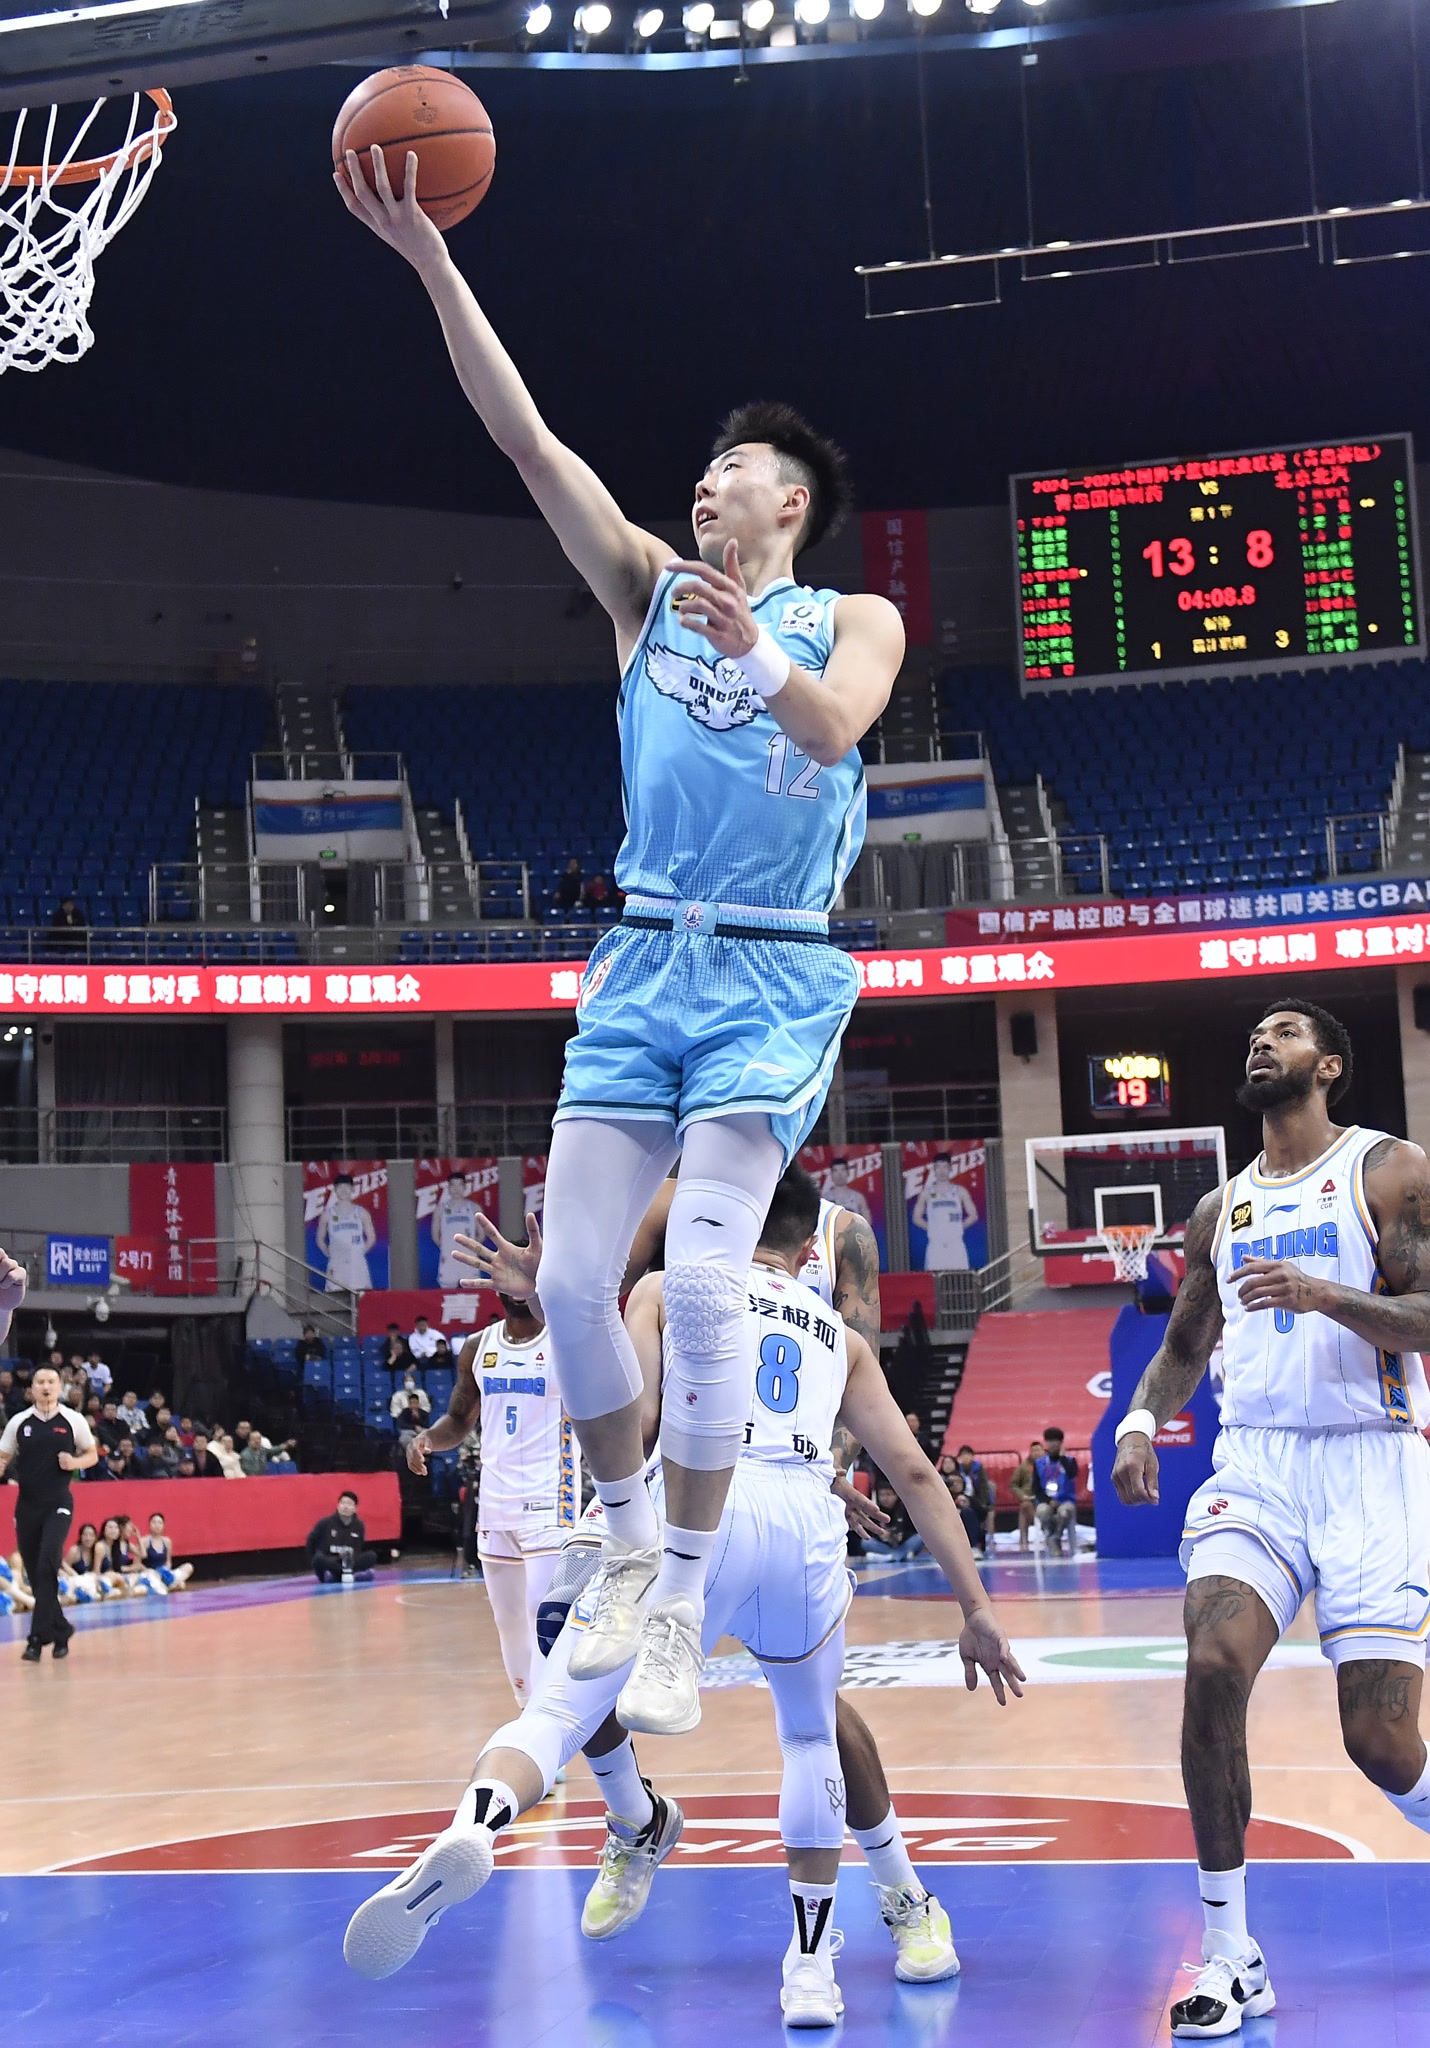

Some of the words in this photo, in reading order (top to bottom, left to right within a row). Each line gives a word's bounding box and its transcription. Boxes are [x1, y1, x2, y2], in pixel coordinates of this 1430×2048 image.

[1199, 481, 1219, 495] VS
[1142, 537, 1196, 578] 13
[1246, 529, 1275, 569] 8
[1177, 585, 1256, 611] 04:08.8
[1151, 641, 1161, 659] 1
[1275, 629, 1290, 648] 3
[765, 731, 820, 801] 12
[978, 880, 1430, 934] 国信产融控股与全国球迷共同关注CBA
[858, 958, 923, 989] 裁判
[941, 950, 1055, 985] 尊重观众
[1199, 932, 1316, 969] 遵守规则
[1335, 923, 1430, 958] 尊重对
[103, 973, 201, 1004] 尊重对手
[325, 973, 420, 1004] 尊重观众
[1117, 1079, 1147, 1106] 19
[74, 1247, 107, 1262] 安全出口
[1231, 1222, 1338, 1269] BEIJING
[79, 1263, 101, 1273] EXIT
[119, 1250, 152, 1270] 2号门
[747, 1292, 837, 1353] 汽极狐
[483, 1376, 545, 1397] BEIJING
[756, 1333, 801, 1414] 8
[506, 1405, 517, 1435] 5
